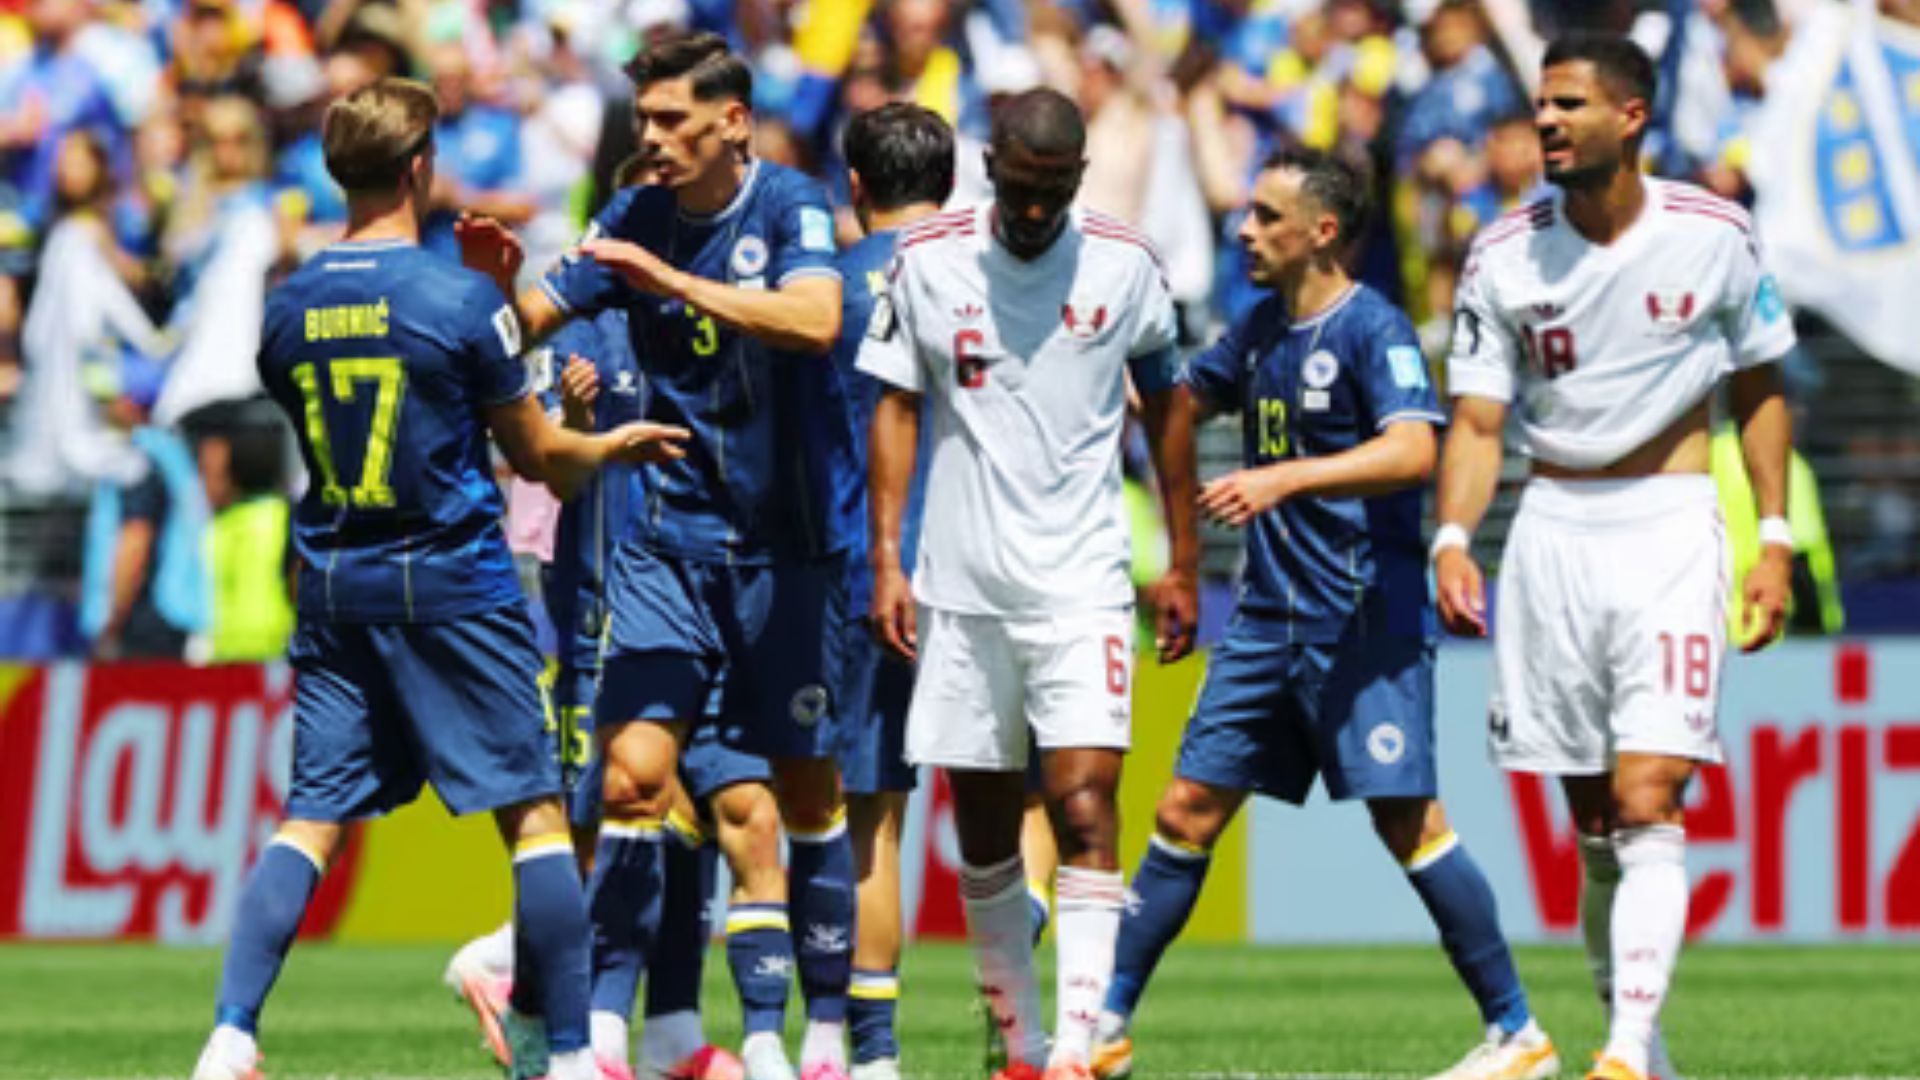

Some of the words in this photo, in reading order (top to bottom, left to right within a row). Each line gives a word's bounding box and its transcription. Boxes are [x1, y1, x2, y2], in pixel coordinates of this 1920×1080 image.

[684, 302, 718, 356] 3
[954, 329, 984, 388] 6
[1521, 321, 1576, 378] 18
[290, 357, 402, 508] 17
[1258, 397, 1287, 457] 13
[1104, 634, 1127, 697] 6
[1657, 630, 1711, 698] 18
[560, 704, 591, 767] 15
